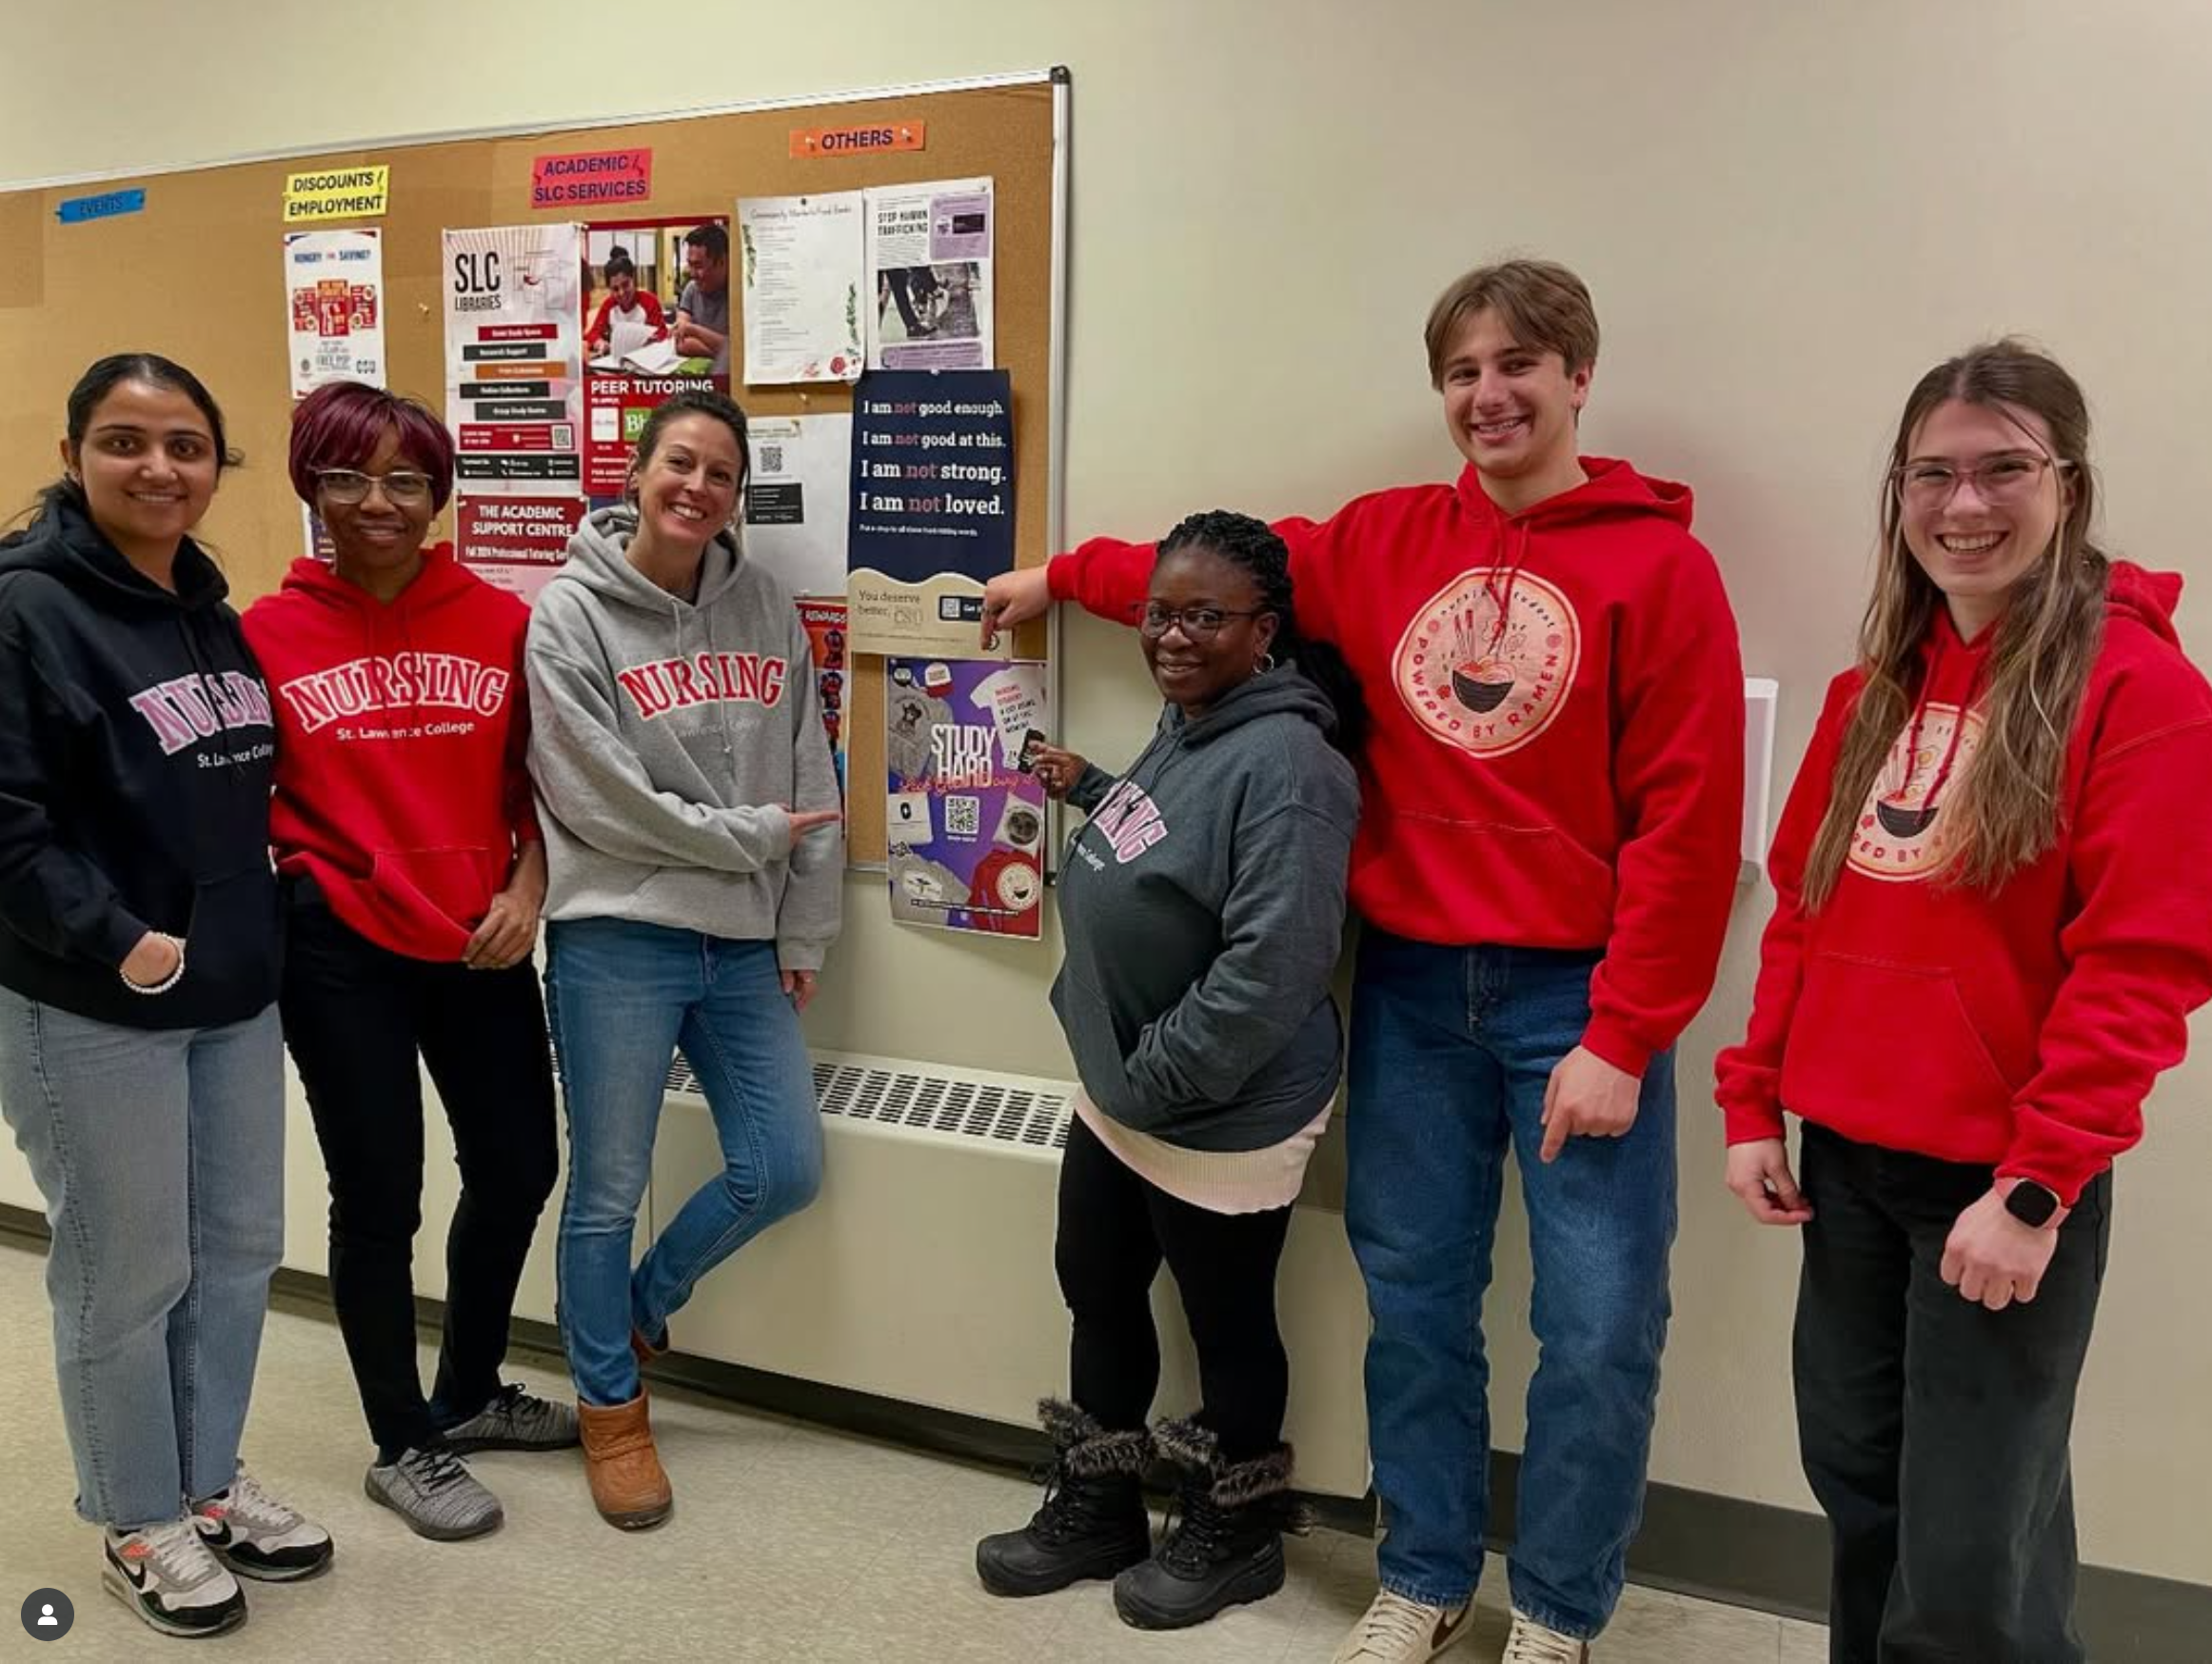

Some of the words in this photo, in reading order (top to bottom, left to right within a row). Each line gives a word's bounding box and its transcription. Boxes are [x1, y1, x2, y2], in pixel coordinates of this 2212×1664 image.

[821, 129, 893, 149] OTHERS
[543, 155, 628, 176] ACADEMIC
[293, 171, 373, 192] DISCOUNTS
[535, 186, 563, 201] SLC
[567, 180, 646, 200] SERVICES
[80, 195, 122, 216] EVENTS
[289, 195, 383, 216] EMPLOYMENT
[878, 212, 897, 224] STOP
[900, 210, 928, 222] HUMAN
[878, 222, 928, 236] TRAFFICKING
[455, 251, 501, 293] SLC
[455, 293, 502, 311] LIBRARIES
[591, 380, 629, 395] PEER
[633, 379, 714, 394] TUTORING
[863, 400, 869, 413] I
[871, 403, 892, 413] am
[895, 402, 918, 413] not
[919, 400, 952, 417] good
[862, 431, 868, 445] I
[871, 434, 892, 445] am
[895, 433, 919, 445] not
[921, 432, 956, 449] good
[958, 434, 974, 446] at
[976, 432, 1006, 446] this.
[861, 460, 868, 477] I
[872, 464, 901, 477] am
[906, 463, 938, 479] not
[940, 464, 1006, 485] strong.
[478, 505, 499, 518] THE
[502, 505, 564, 520] ACADEMIC
[859, 492, 868, 510] I
[872, 496, 903, 511] am
[908, 497, 942, 512] not
[945, 493, 1005, 515] loved.
[472, 522, 524, 536] SUPPORT
[525, 523, 572, 537] CENTRE
[859, 590, 878, 601] You
[879, 591, 920, 604] deserve
[1513, 591, 1555, 628] tudent
[279, 651, 510, 734] NURSING
[616, 651, 787, 721] NURSING
[1412, 636, 1462, 731] POWERED
[1472, 723, 1496, 739] BY
[1508, 654, 1558, 727] RAMEN
[337, 727, 356, 741] St.
[425, 721, 474, 735] College
[931, 723, 996, 757] STUDY
[197, 753, 212, 768] St.
[938, 755, 993, 787] HARD
[1897, 848, 1921, 862] BY
